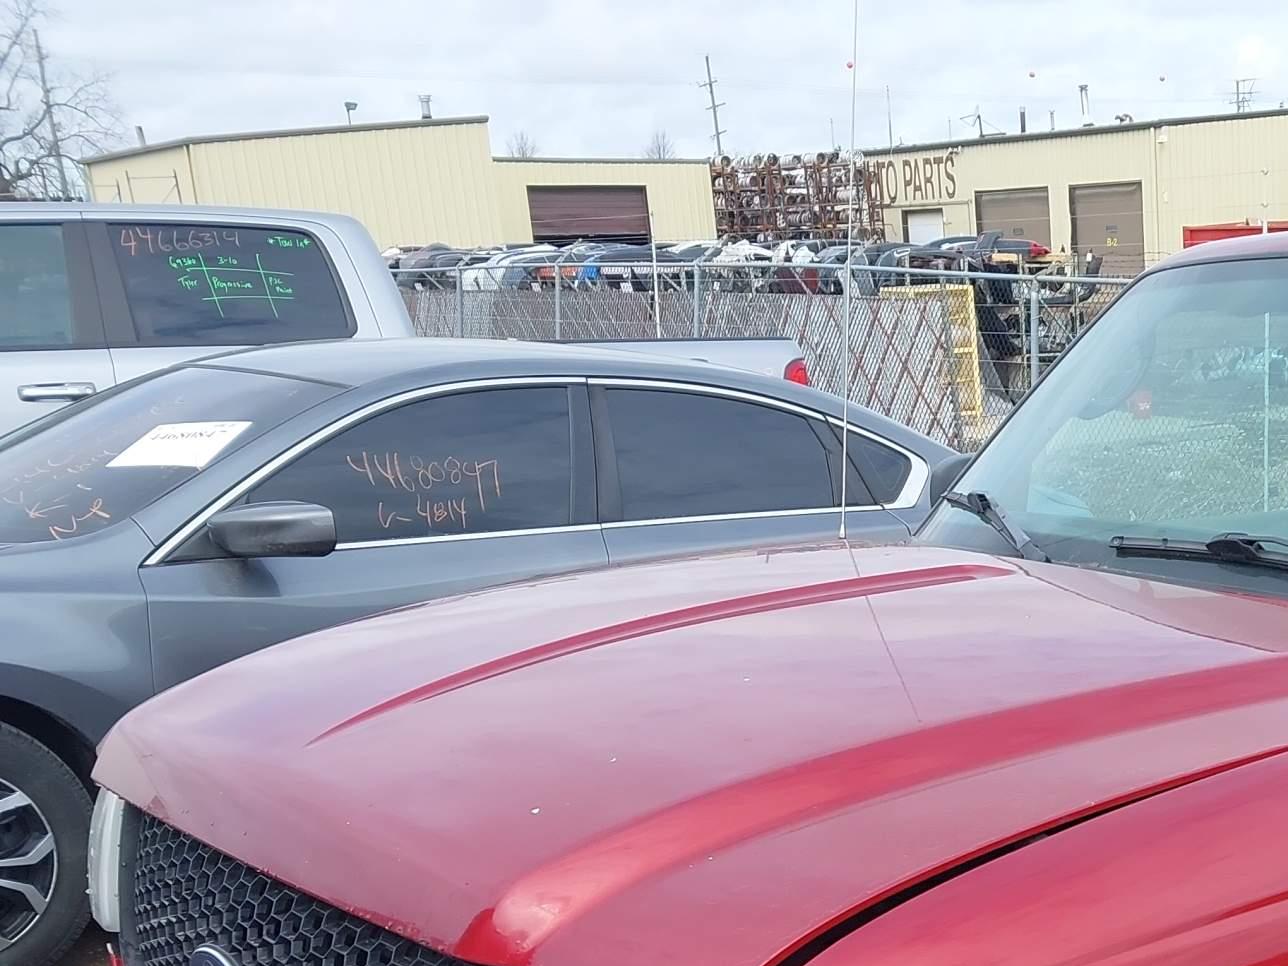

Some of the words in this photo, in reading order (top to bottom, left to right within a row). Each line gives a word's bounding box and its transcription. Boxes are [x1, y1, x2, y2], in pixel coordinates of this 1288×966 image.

[866, 159, 898, 203] UTO
[903, 156, 957, 201] PARTS
[120, 227, 240, 256] 44666314
[347, 451, 500, 511] 44680847
